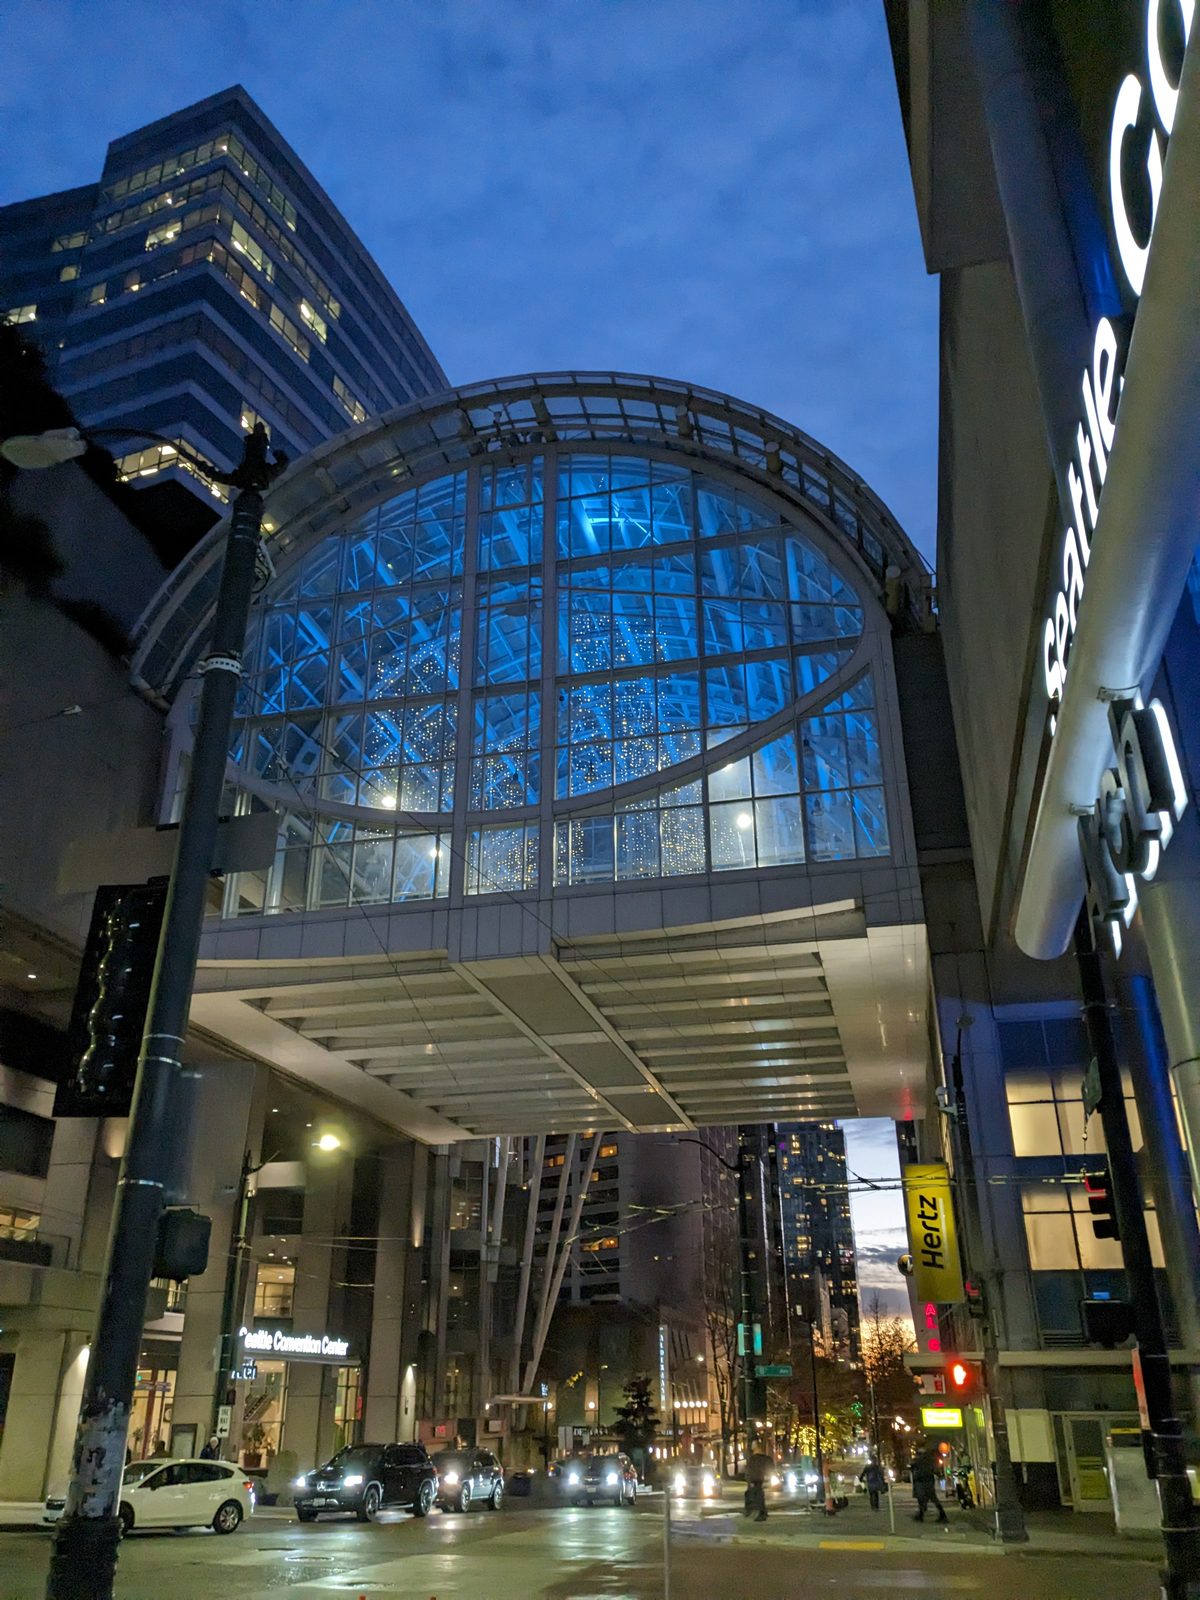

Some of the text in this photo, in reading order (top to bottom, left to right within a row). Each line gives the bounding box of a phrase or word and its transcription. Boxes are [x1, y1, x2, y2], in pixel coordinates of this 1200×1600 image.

[918, 1194, 944, 1269] Hertz
[273, 1330, 322, 1354] Convention
[321, 1335, 349, 1356] Center
